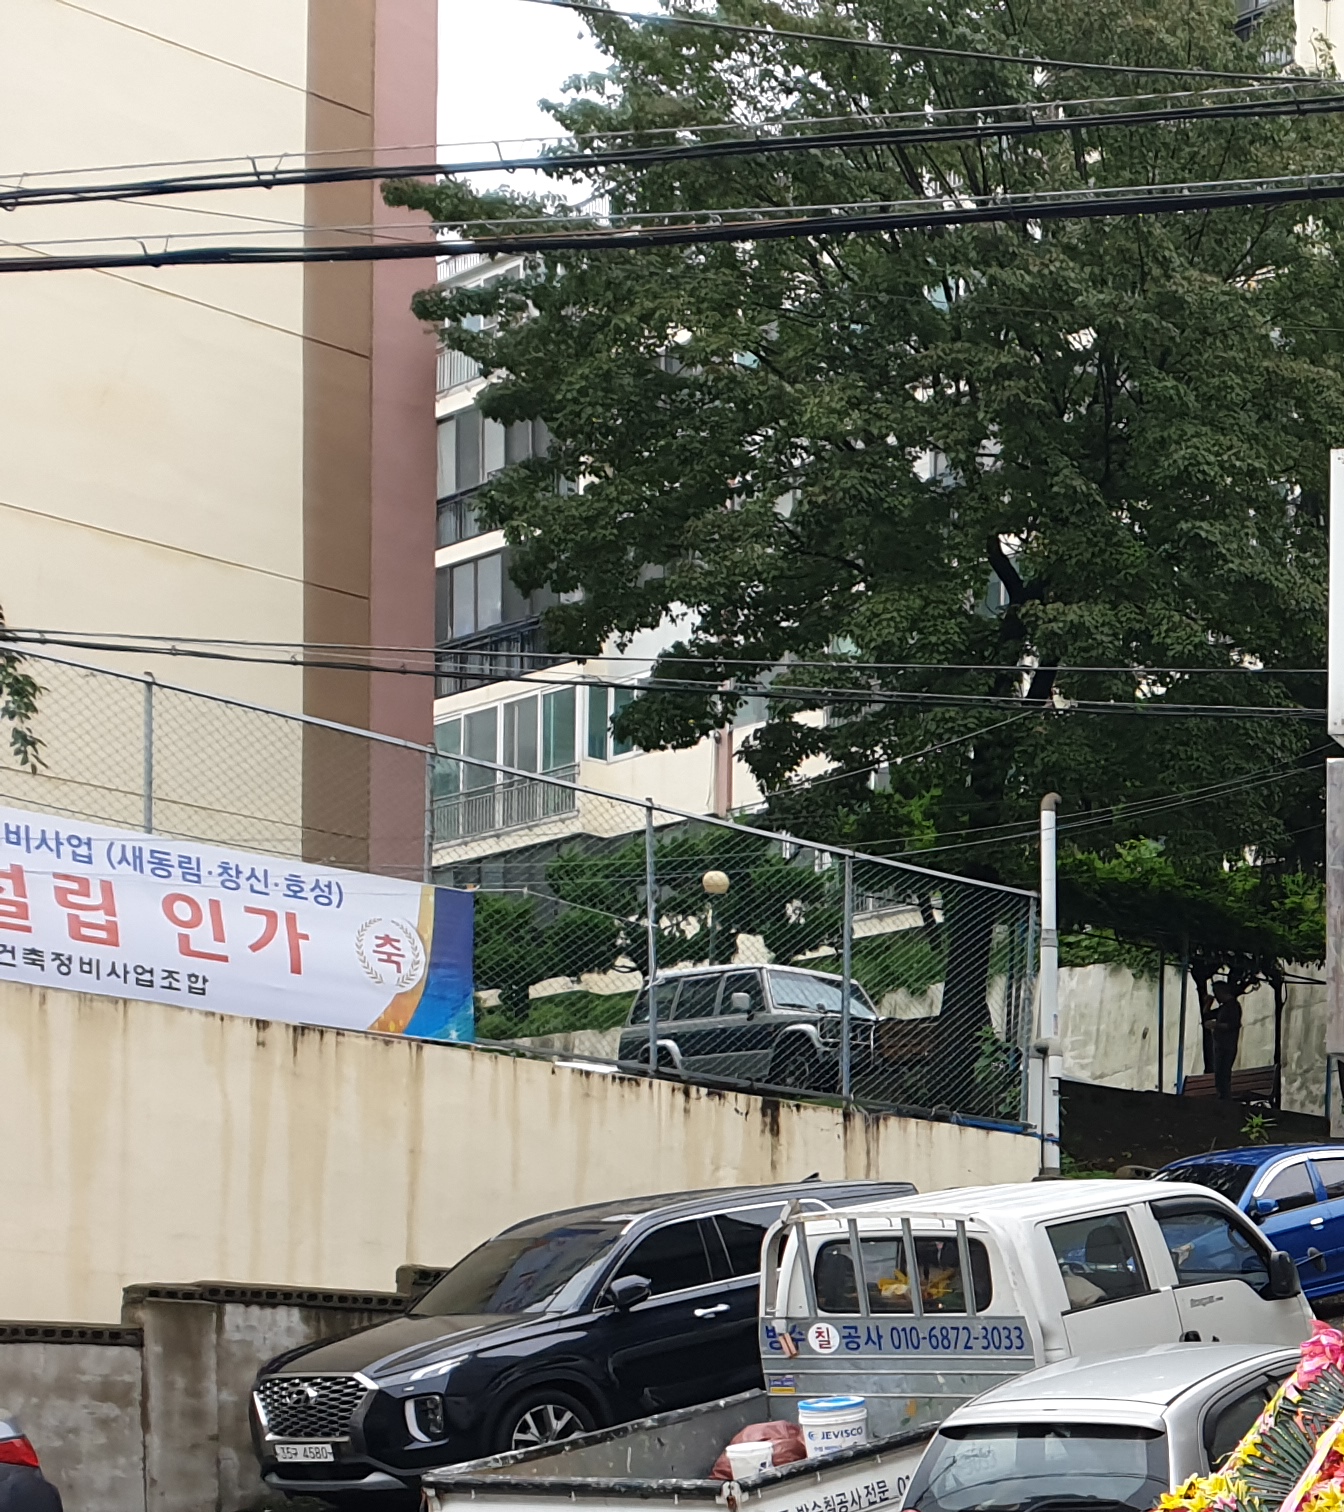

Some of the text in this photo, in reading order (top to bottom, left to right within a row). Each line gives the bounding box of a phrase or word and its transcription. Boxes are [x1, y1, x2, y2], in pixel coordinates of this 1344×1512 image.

[161, 890, 310, 976] 인가
[372, 933, 403, 974] 축
[842, 1324, 884, 1351] 공사
[890, 1325, 1025, 1351] 010-6872-3033
[820, 1426, 863, 1440] JEVISCO
[864, 1479, 890, 1504] 전문
